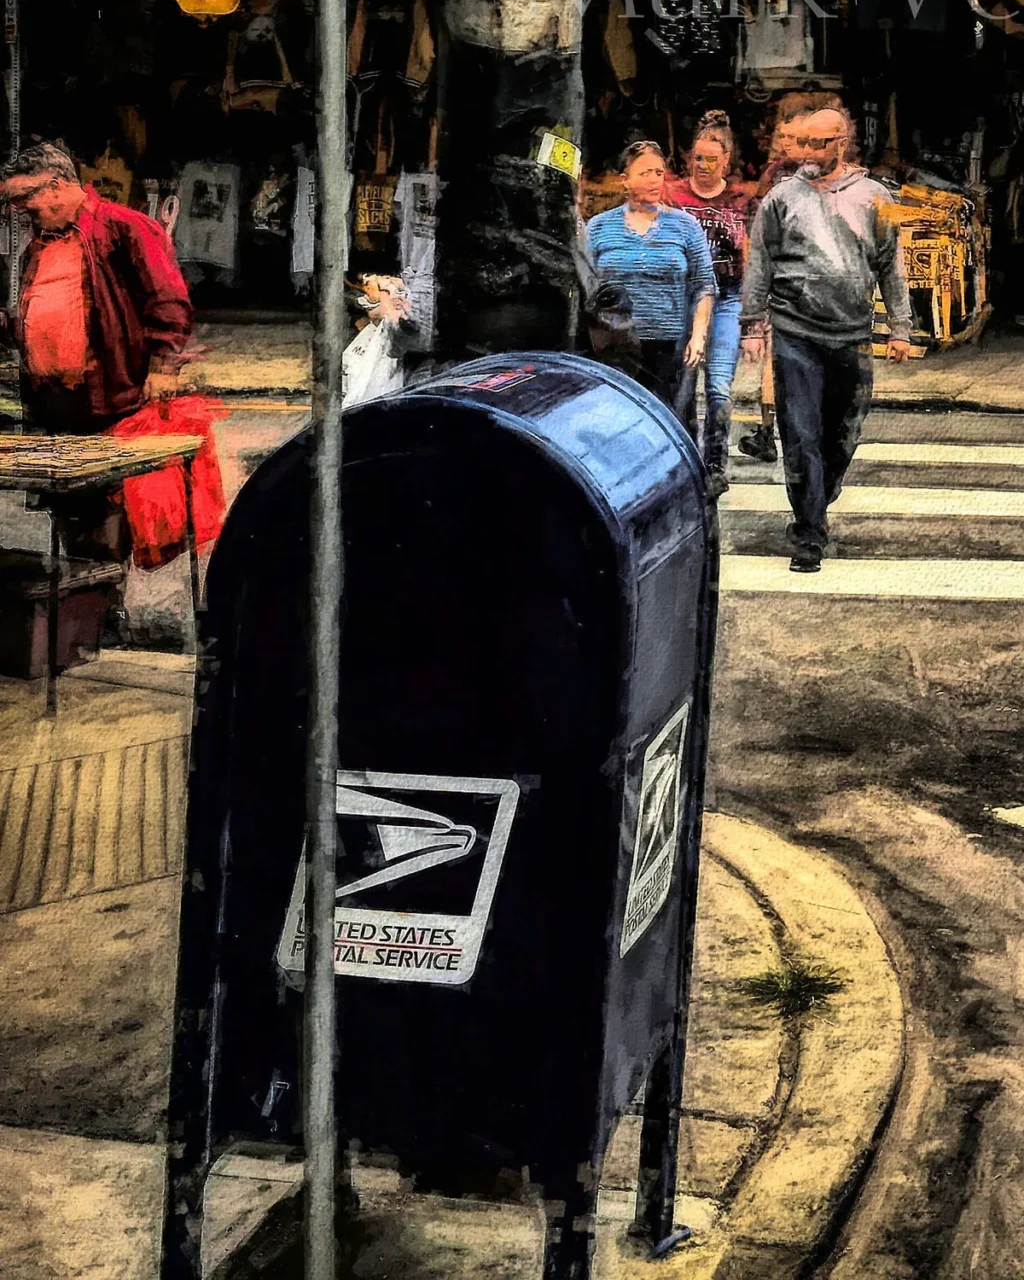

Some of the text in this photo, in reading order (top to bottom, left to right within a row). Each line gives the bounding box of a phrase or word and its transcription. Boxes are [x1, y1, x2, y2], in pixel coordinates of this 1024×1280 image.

[296, 917, 457, 946] UTED STATES
[291, 939, 462, 971] PTAL SERVICE
